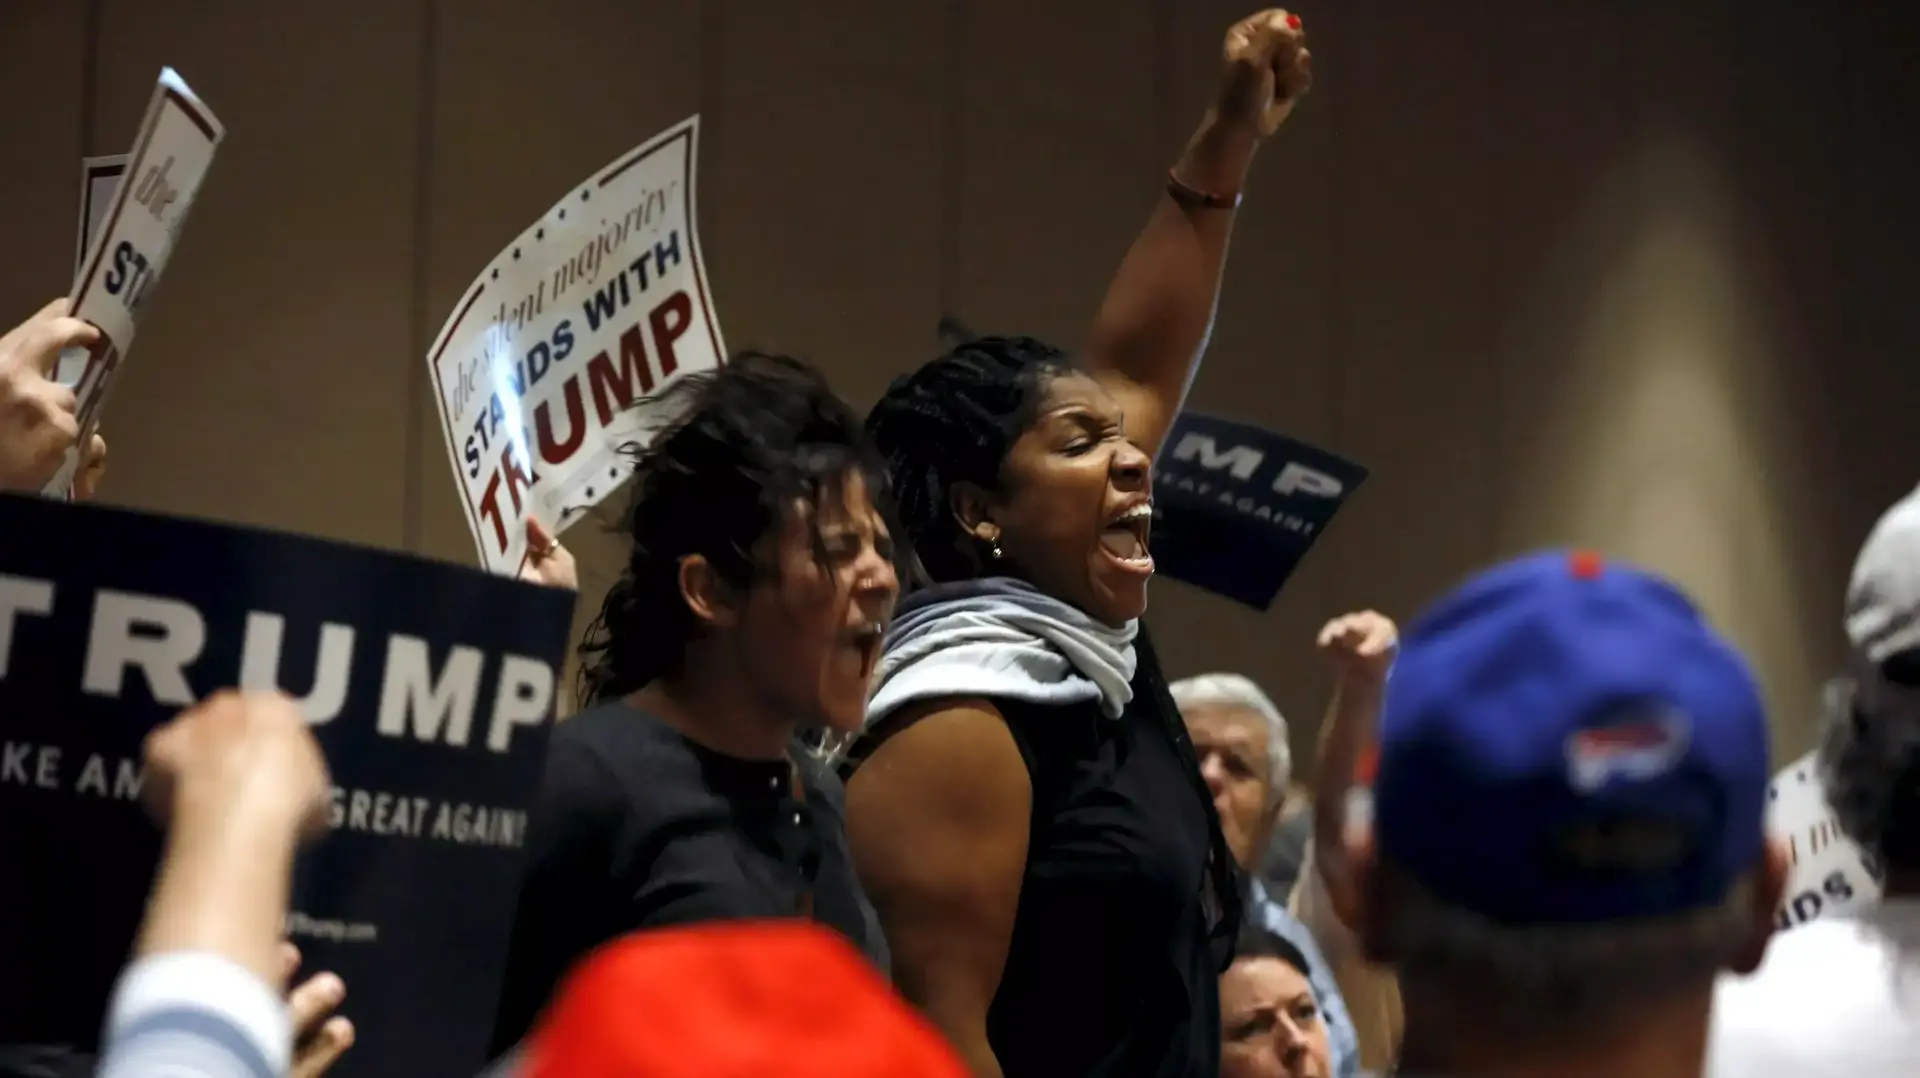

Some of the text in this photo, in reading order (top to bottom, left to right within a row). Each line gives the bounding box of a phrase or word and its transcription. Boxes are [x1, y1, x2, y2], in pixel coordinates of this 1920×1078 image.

[453, 357, 478, 422] the
[553, 180, 678, 302] majority
[465, 229, 681, 479] STANDS WITH
[480, 289, 693, 555] TRUMP
[1172, 431, 1343, 497] MP
[328, 785, 430, 838] GREAT
